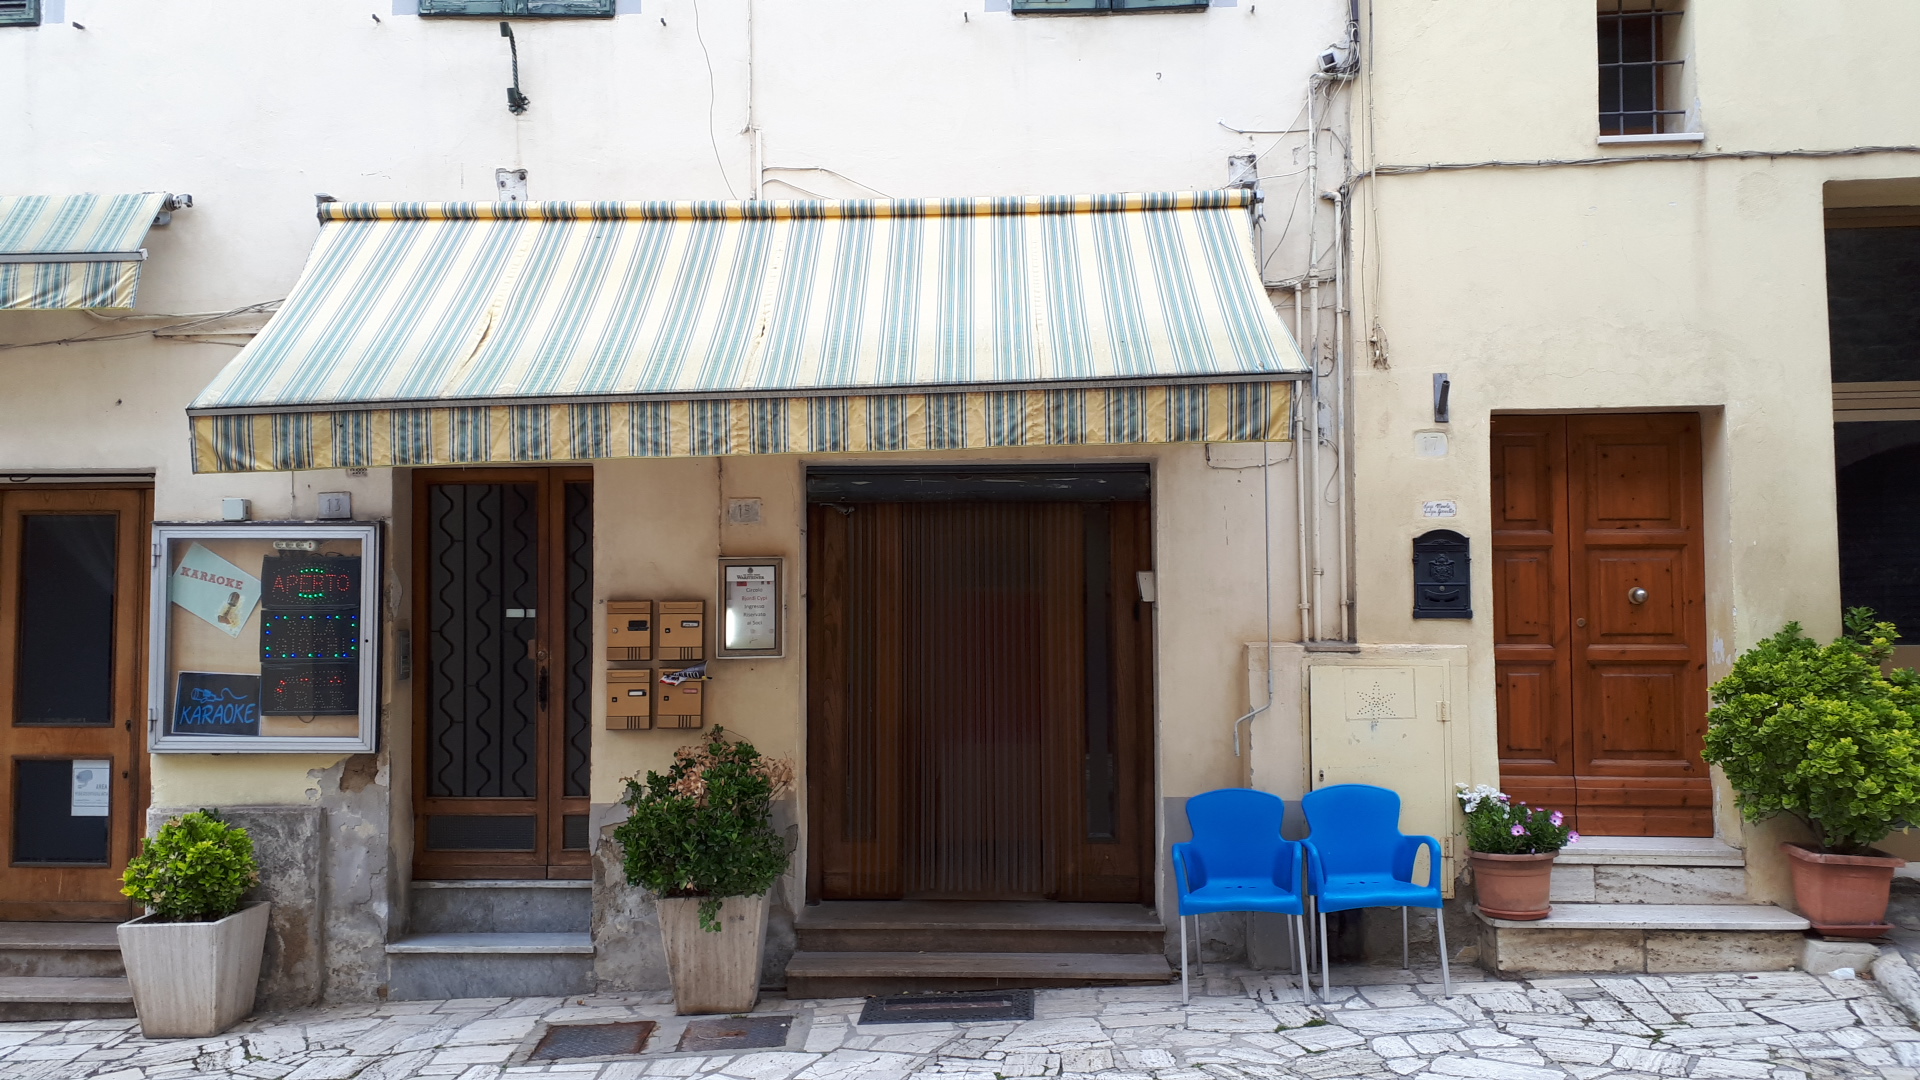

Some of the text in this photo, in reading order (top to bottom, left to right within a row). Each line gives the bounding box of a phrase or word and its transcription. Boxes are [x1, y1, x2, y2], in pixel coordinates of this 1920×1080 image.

[1422, 436, 1438, 451] 17
[327, 498, 341, 512] 13
[180, 566, 244, 590] KARAOKE
[272, 574, 350, 593] APERTO
[286, 620, 336, 637] SALA
[275, 637, 346, 654] GIOCHI
[293, 690, 348, 709] BAR
[180, 703, 256, 726] KARAOKE
